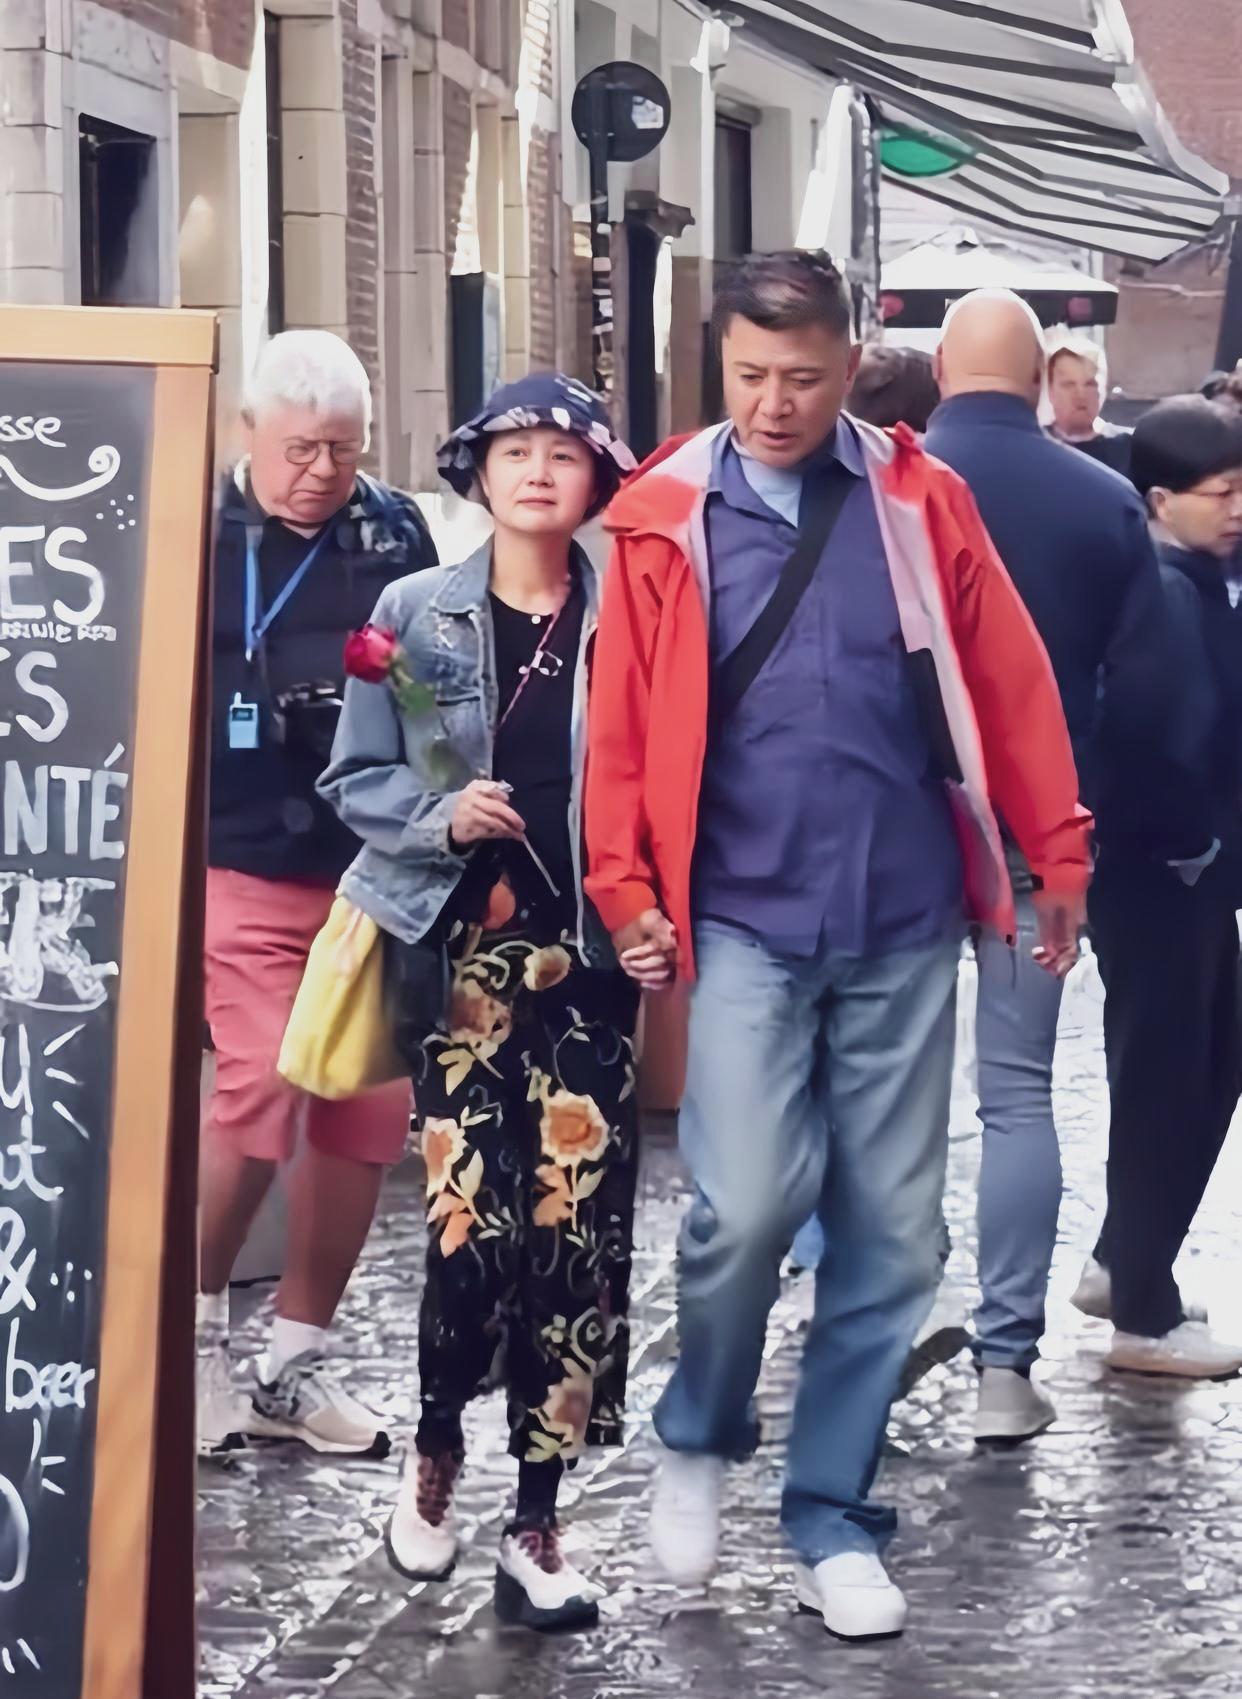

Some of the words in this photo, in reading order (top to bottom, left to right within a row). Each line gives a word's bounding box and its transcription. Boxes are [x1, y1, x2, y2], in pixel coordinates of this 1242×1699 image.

[0, 525, 104, 625] ES
[4, 742, 128, 860] NTÉ
[5, 1317, 95, 1412] beer
